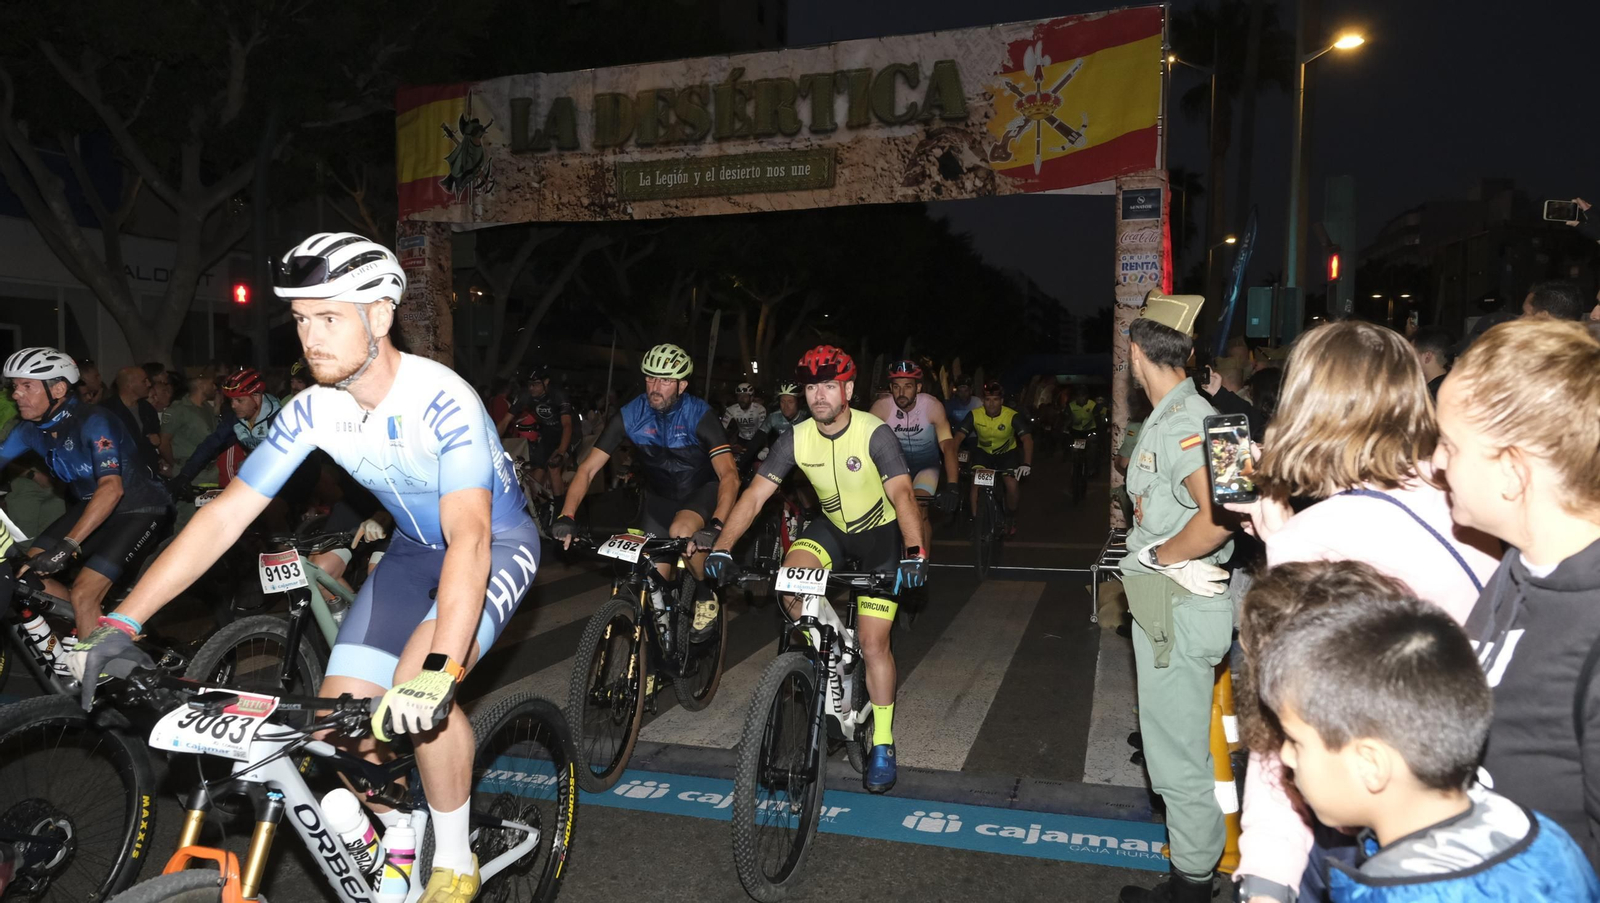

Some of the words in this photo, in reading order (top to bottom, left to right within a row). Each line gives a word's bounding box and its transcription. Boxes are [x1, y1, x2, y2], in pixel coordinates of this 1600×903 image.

[509, 96, 580, 153] LA
[592, 58, 969, 149] DESÉRTICA
[639, 173, 652, 187] La
[655, 170, 689, 189] Legión
[694, 173, 701, 187] y
[705, 168, 715, 182] el
[719, 166, 761, 181] desierto
[767, 165, 785, 178] nos
[791, 164, 811, 177] une
[1121, 261, 1158, 271] RENTA
[266, 394, 315, 455] HLN
[335, 421, 363, 433] GOBIK
[422, 389, 473, 455] HLN
[767, 472, 783, 484] PORC
[608, 539, 640, 552] 6182
[265, 562, 300, 582] 9193
[786, 567, 825, 582] 6570
[486, 545, 538, 624] HLN
[860, 600, 889, 614] PORCUNA
[397, 687, 439, 701] 100%
[177, 709, 255, 744] 9083
[186, 741, 230, 754] cajamar
[563, 777, 575, 847] SCORPION
[131, 795, 150, 860] MAXXIS
[975, 823, 1167, 854] cajamar
[1069, 845, 1111, 855] CAJA
[1116, 850, 1170, 861] RURAL
